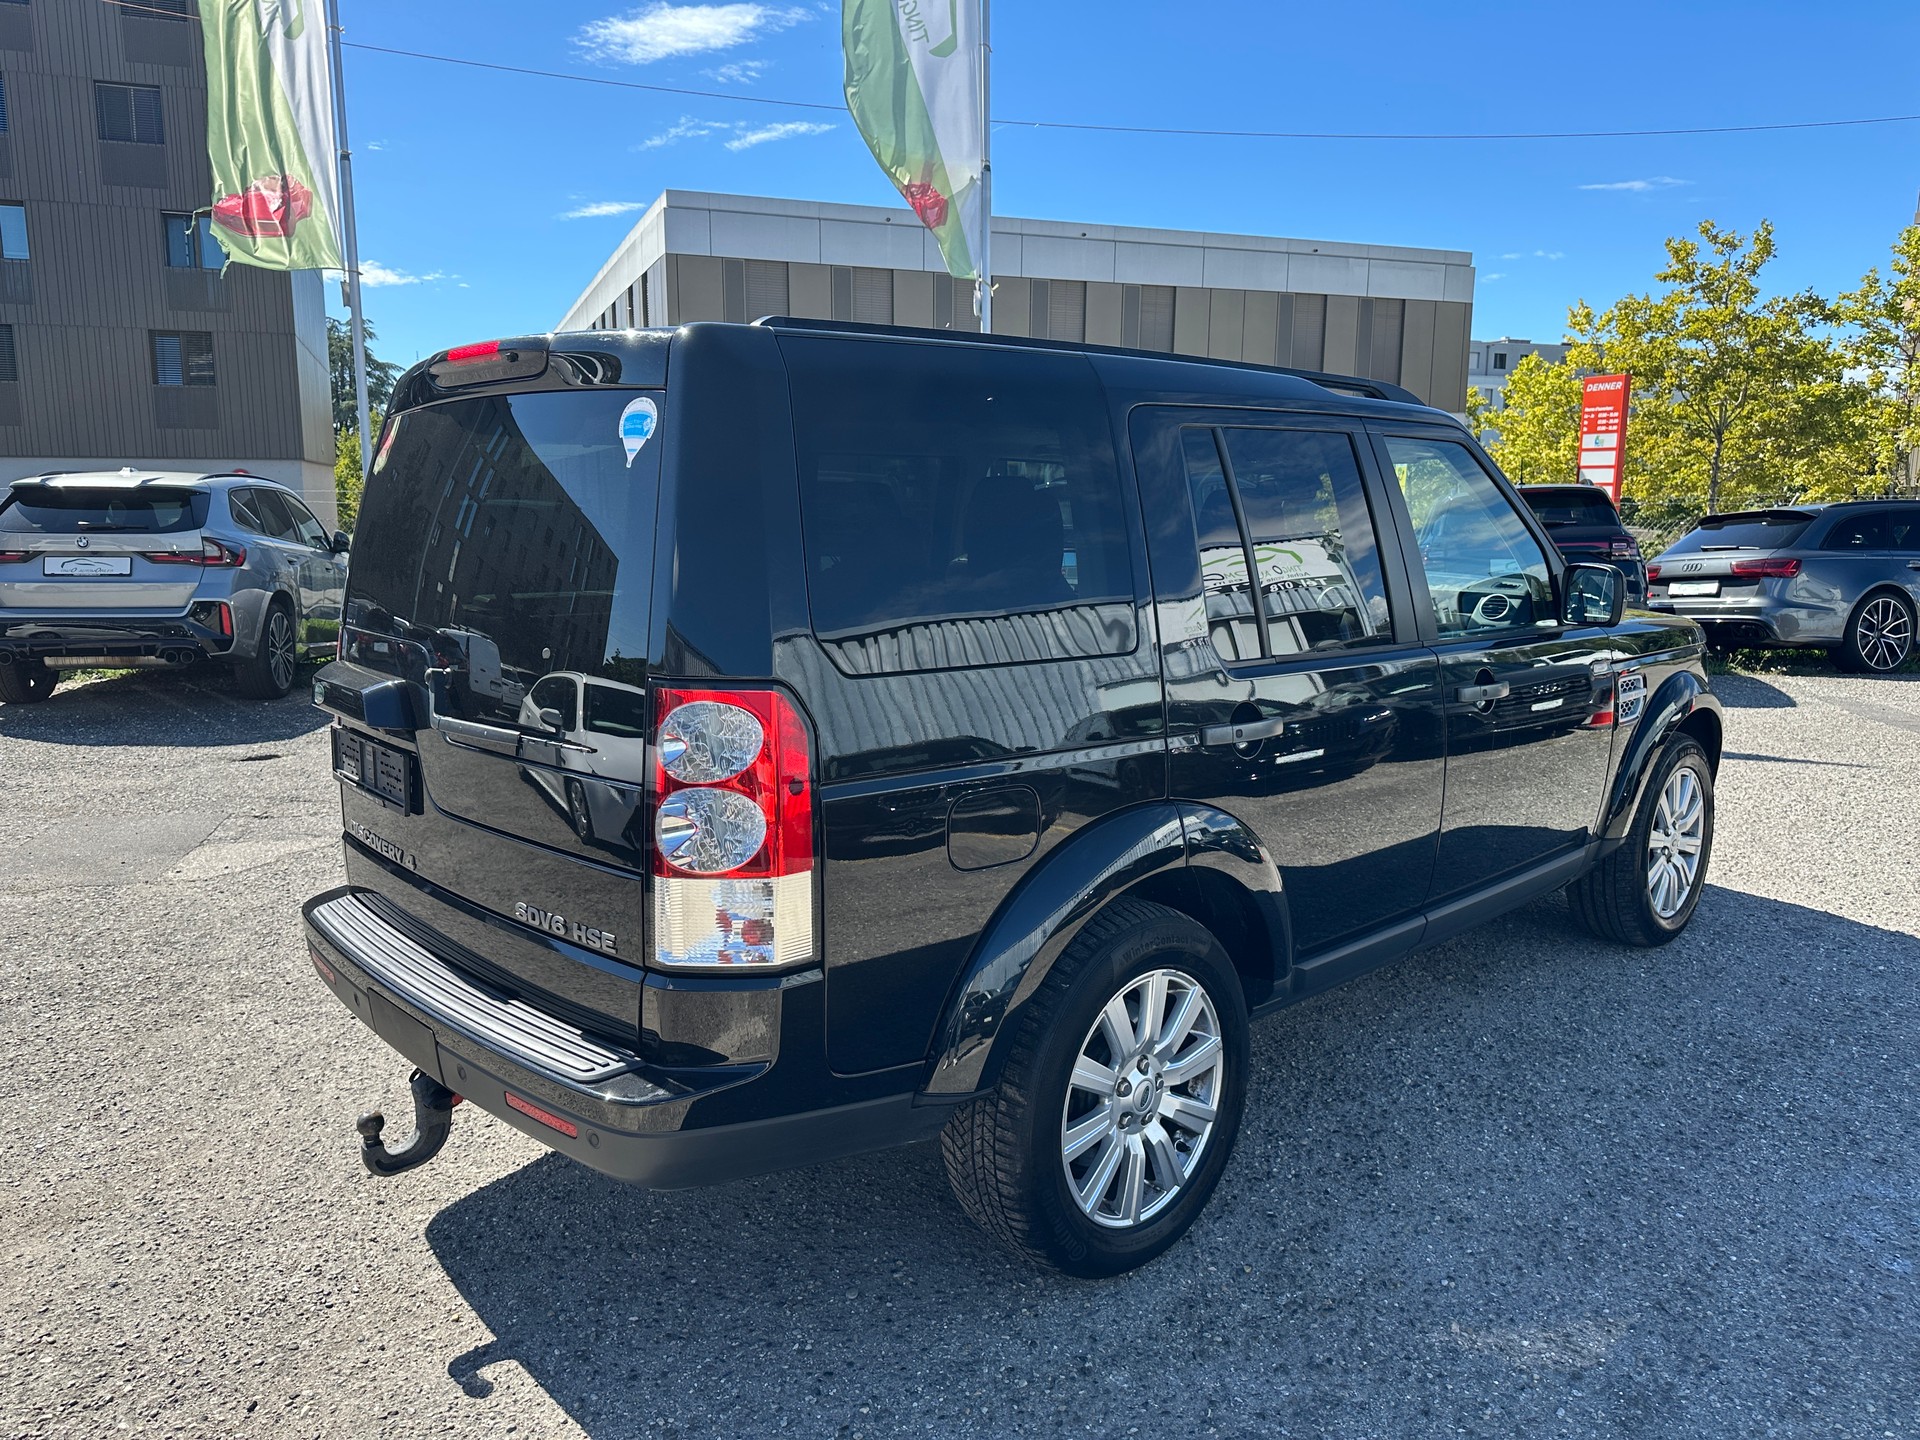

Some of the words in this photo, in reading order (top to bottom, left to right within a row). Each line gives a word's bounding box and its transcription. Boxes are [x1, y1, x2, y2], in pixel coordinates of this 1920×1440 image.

[1586, 382, 1622, 392] DENNER
[350, 820, 404, 863] DISCOVERY
[405, 853, 417, 870] 4
[515, 902, 567, 935] SDV6
[573, 922, 618, 954] HSE
